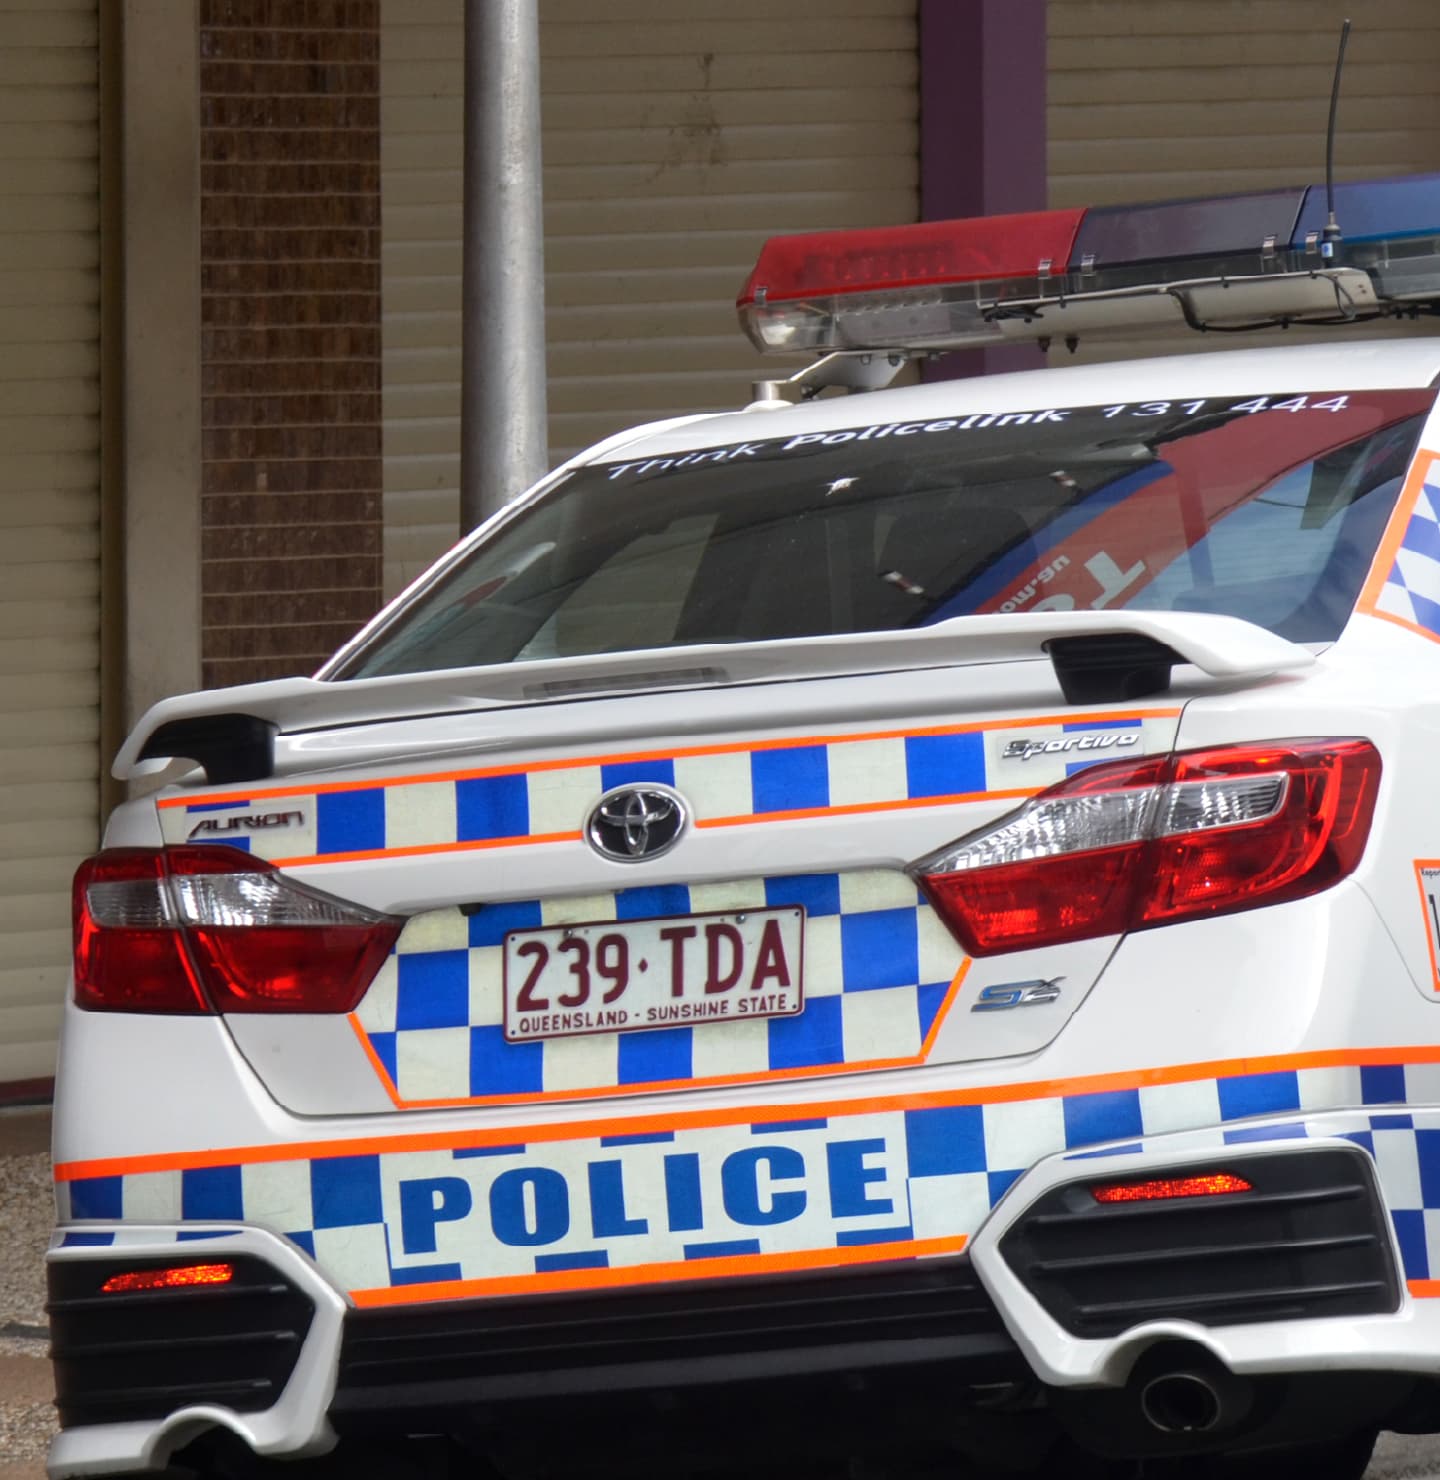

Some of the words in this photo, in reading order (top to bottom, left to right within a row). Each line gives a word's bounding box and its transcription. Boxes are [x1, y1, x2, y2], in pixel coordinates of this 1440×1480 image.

[608, 443, 767, 480] Think
[783, 408, 1074, 450] Policelink
[1103, 400, 1207, 418] 131
[1230, 395, 1350, 414] 444
[1003, 733, 1140, 760] Sportivo
[187, 810, 305, 840] AURION
[516, 934, 629, 1012] 239
[660, 920, 791, 997] TDA
[519, 1010, 628, 1033] QUEENSLAND
[647, 1000, 729, 1021] SUNSHINE
[738, 994, 788, 1013] STATE
[399, 1137, 894, 1255] POLICE
